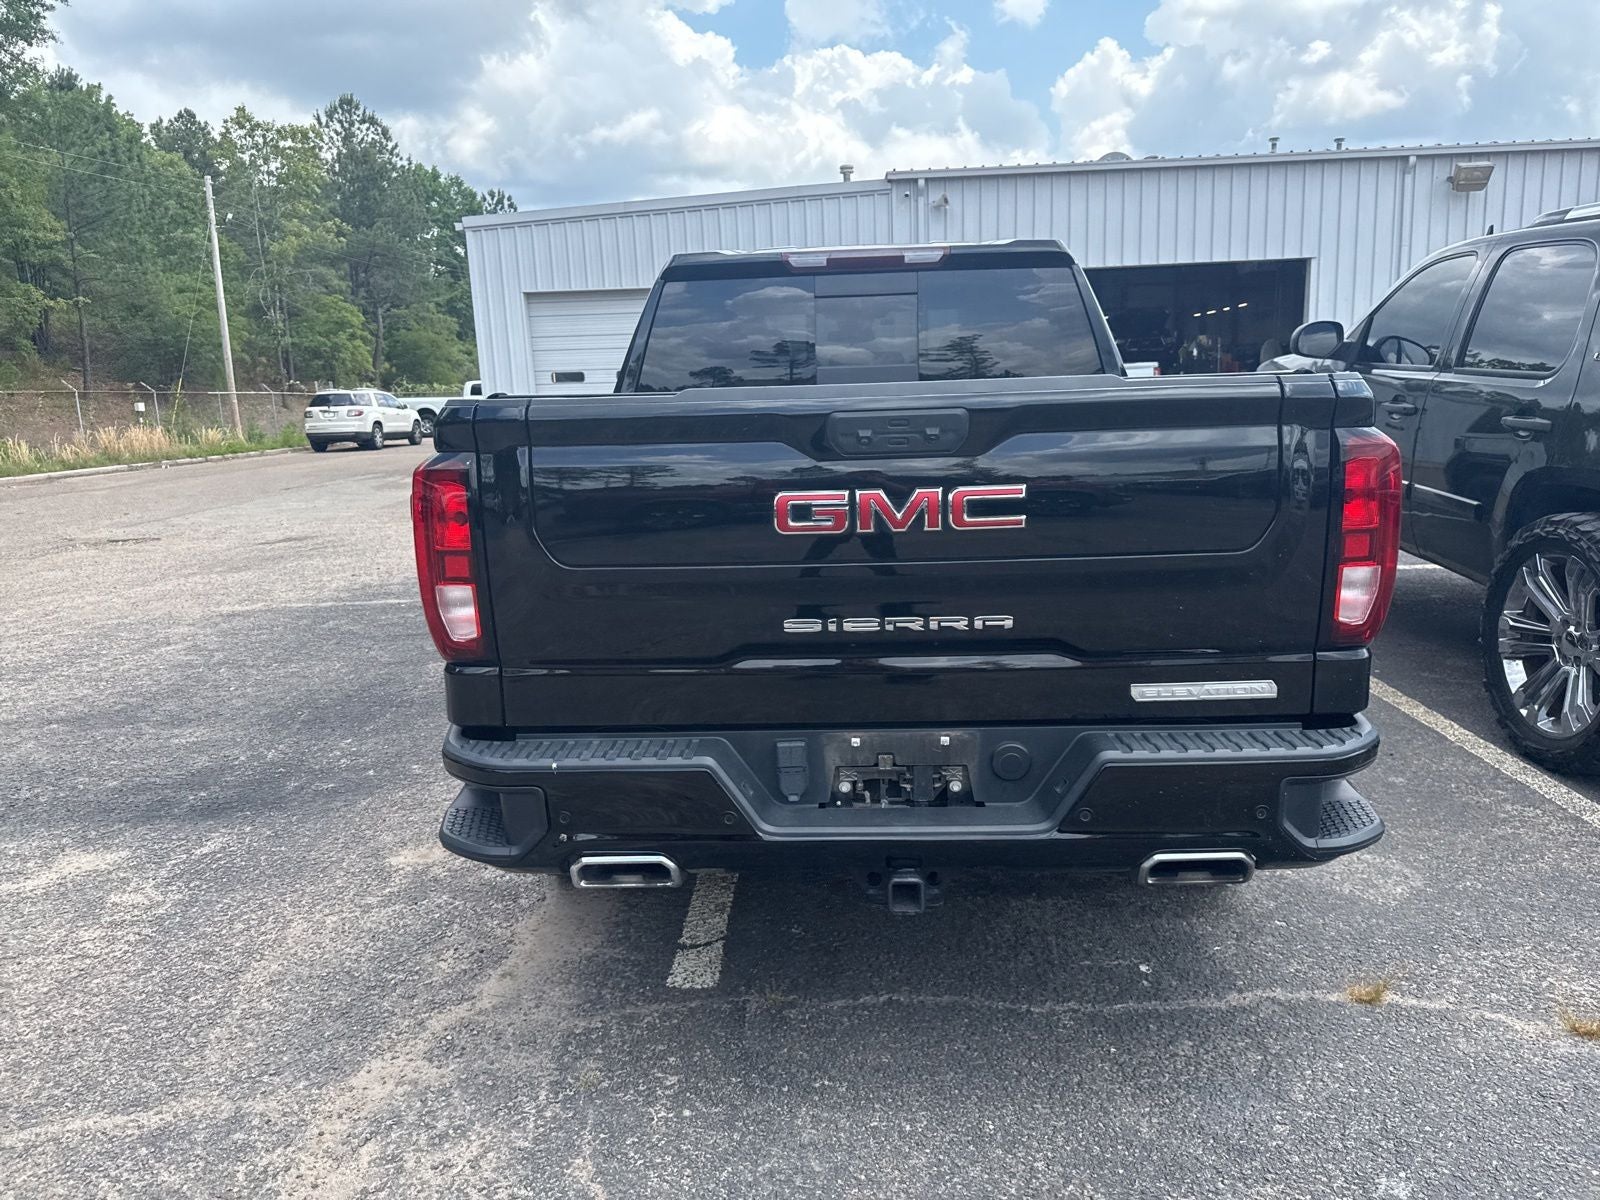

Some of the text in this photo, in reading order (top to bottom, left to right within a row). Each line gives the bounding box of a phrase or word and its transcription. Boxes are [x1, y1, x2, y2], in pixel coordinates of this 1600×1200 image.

[773, 483, 1027, 535] GMC
[783, 615, 1014, 633] SIERRA
[1138, 683, 1273, 699] ELEVATION
